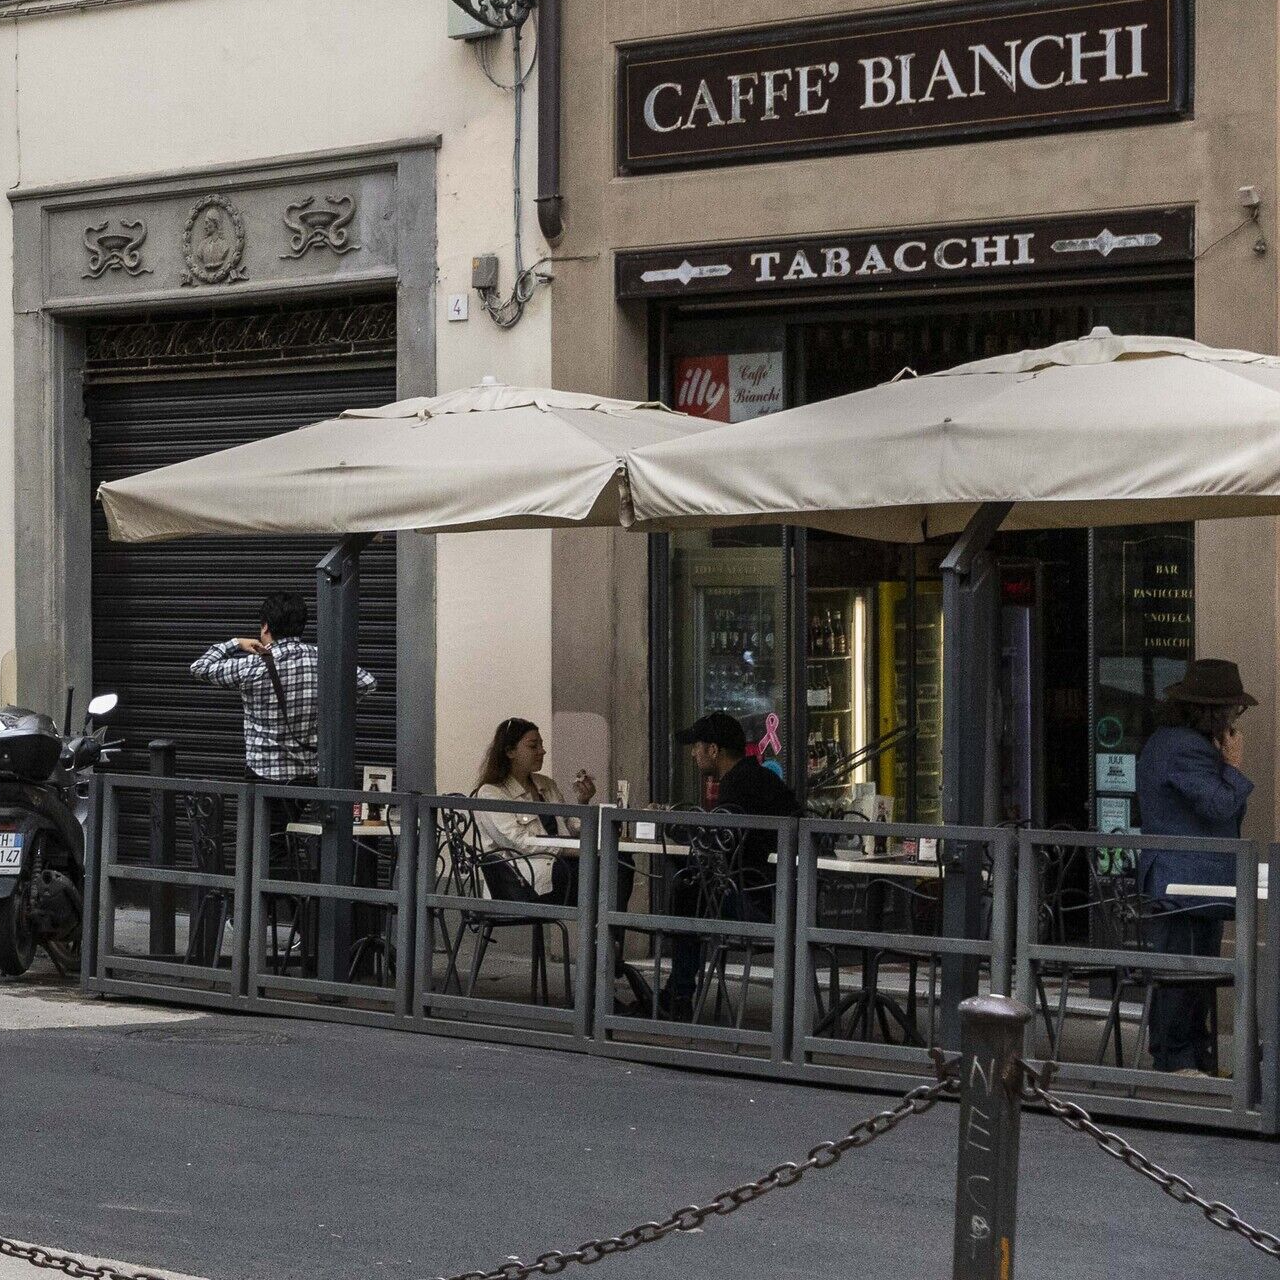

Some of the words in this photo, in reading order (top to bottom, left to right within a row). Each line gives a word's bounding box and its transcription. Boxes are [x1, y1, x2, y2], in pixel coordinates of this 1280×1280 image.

[642, 60, 840, 133] CAFFE'
[858, 23, 1149, 110] BIANCHI
[750, 233, 1036, 283] TABACCHI
[678, 367, 726, 415] illy
[733, 387, 782, 404] Bianchi
[1156, 564, 1179, 575] BAR
